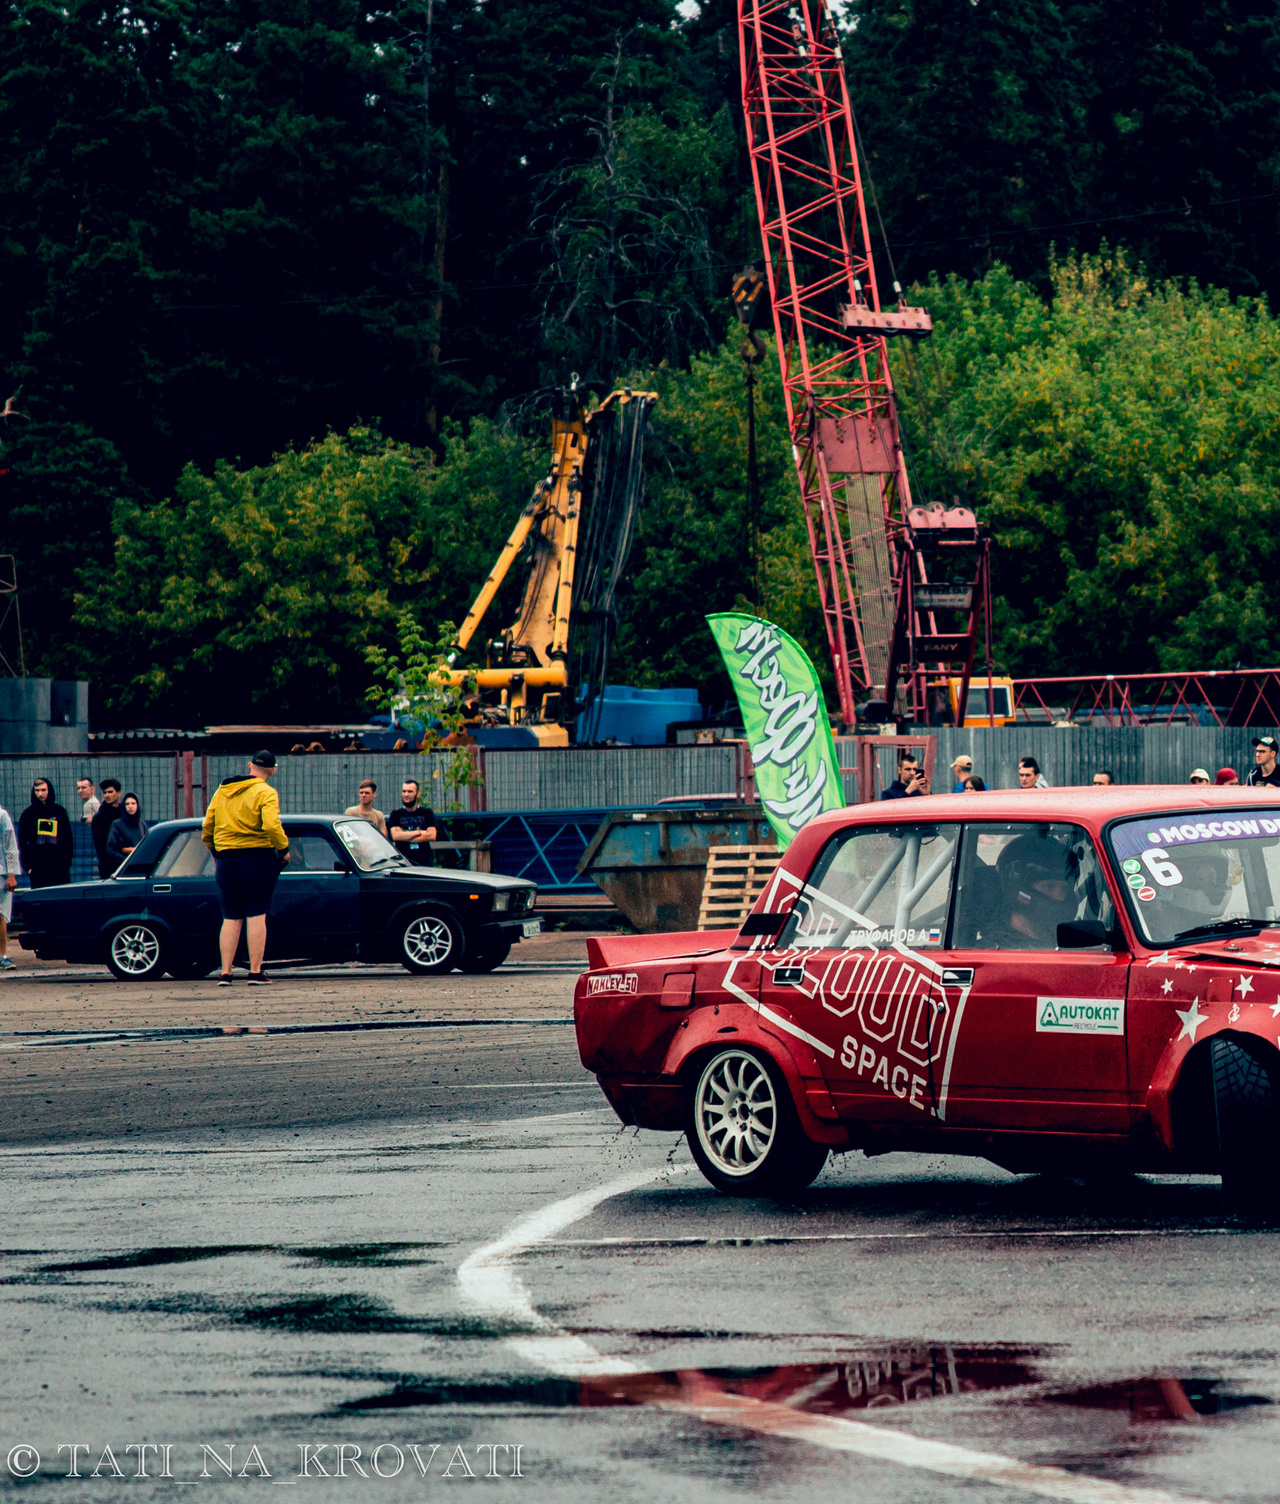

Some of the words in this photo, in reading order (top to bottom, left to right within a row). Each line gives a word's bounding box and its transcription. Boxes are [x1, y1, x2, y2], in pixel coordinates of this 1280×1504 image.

[1159, 819, 1261, 844] MOSCOW
[1141, 848, 1183, 887] 6
[850, 929, 916, 943] ТРУФАНОВ
[757, 891, 951, 1067] CLOUD
[1060, 1005, 1120, 1021] AUTOKAT
[1073, 1023, 1097, 1031] RECYCLE
[840, 1035, 928, 1111] SPACE
